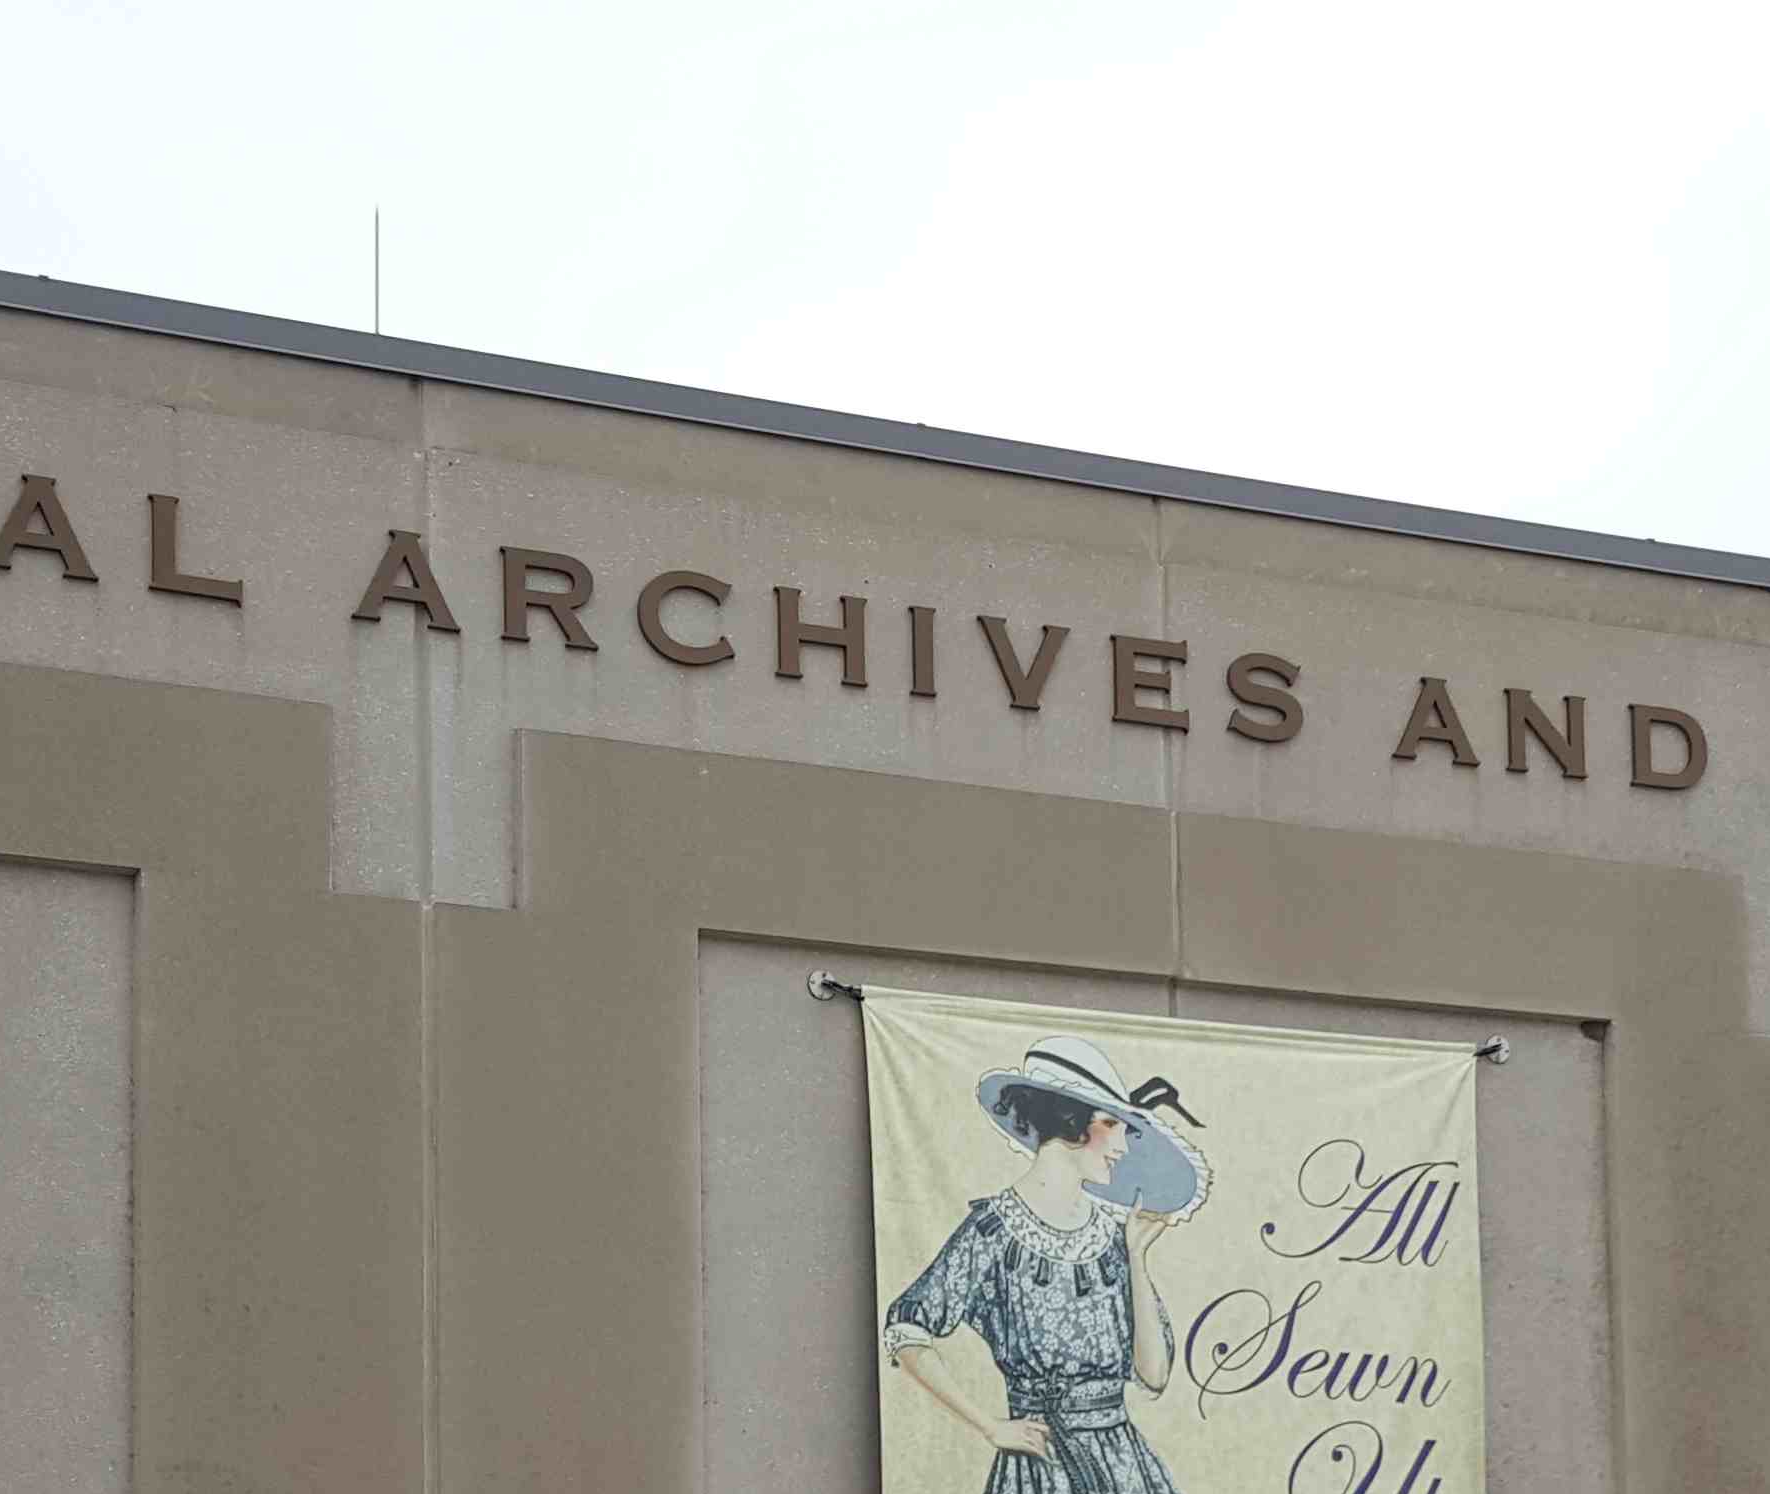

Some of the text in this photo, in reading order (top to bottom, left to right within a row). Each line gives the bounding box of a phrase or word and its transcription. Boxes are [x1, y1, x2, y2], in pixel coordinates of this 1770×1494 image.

[350, 530, 1306, 744] ARCHIVES
[1391, 676, 1710, 792] AND
[1260, 1138, 1460, 1267] All
[1184, 1280, 1451, 1420] Sewn
